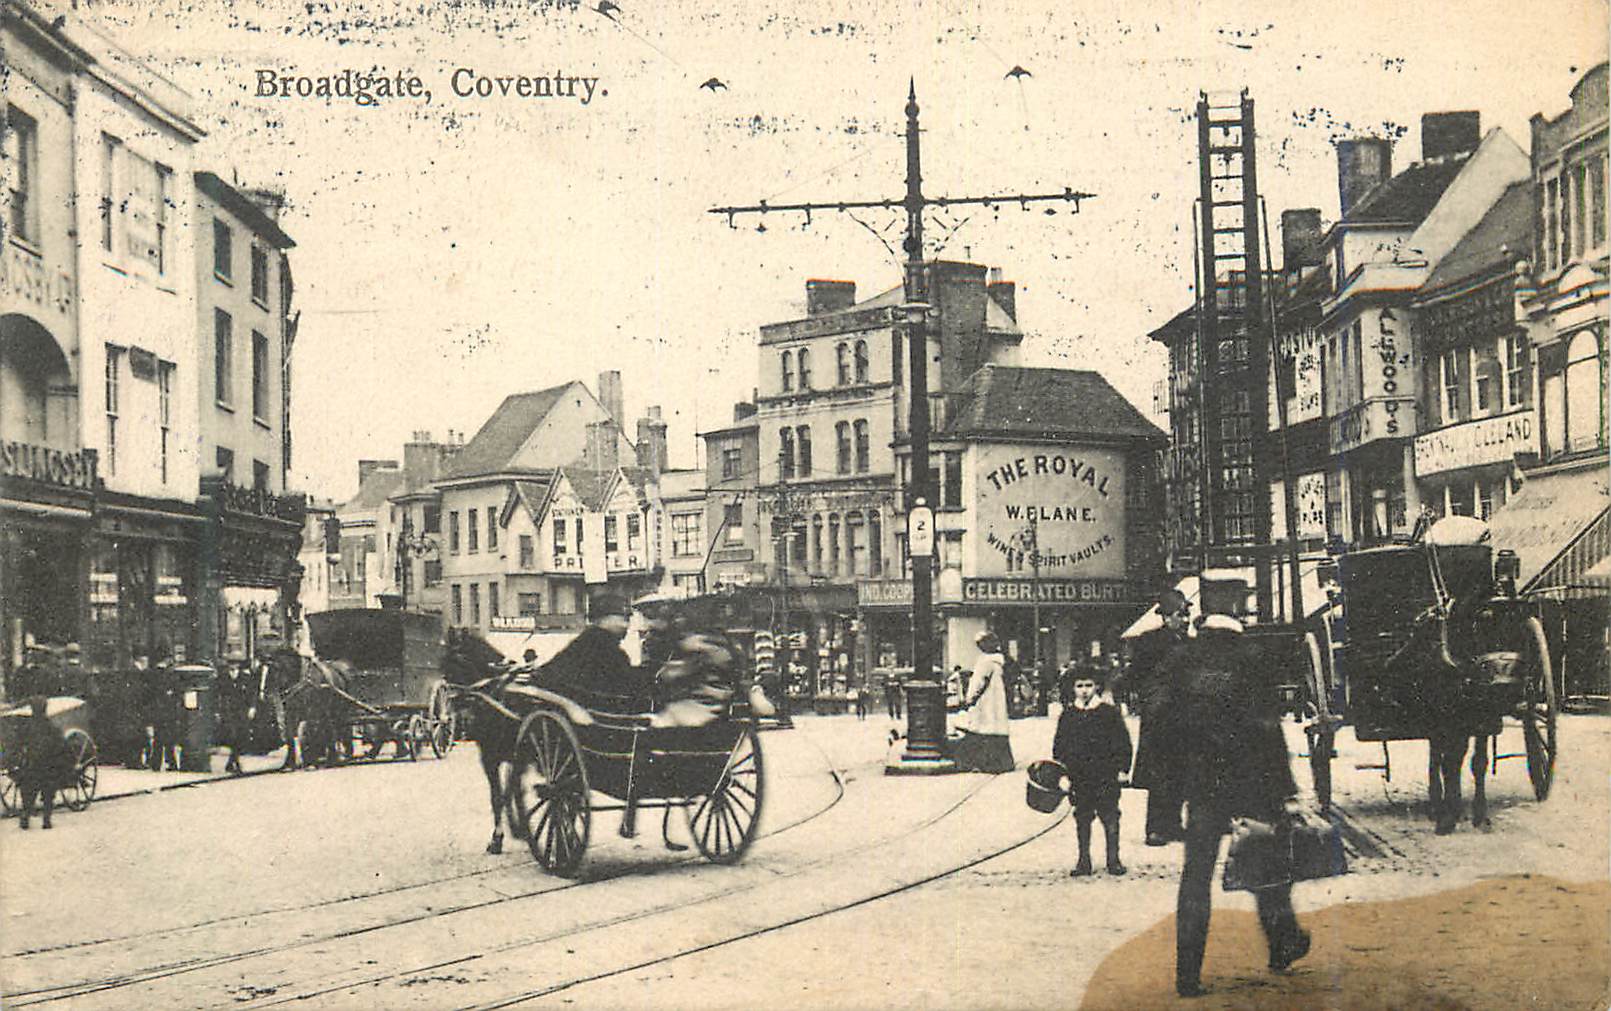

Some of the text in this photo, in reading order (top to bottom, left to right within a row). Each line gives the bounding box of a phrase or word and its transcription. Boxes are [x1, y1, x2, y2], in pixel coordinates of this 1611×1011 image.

[987, 455, 1110, 497] THE ROYAL
[917, 520, 926, 531] 2
[554, 554, 639, 570] PRIER
[965, 582, 1077, 600] CELEBRATED
